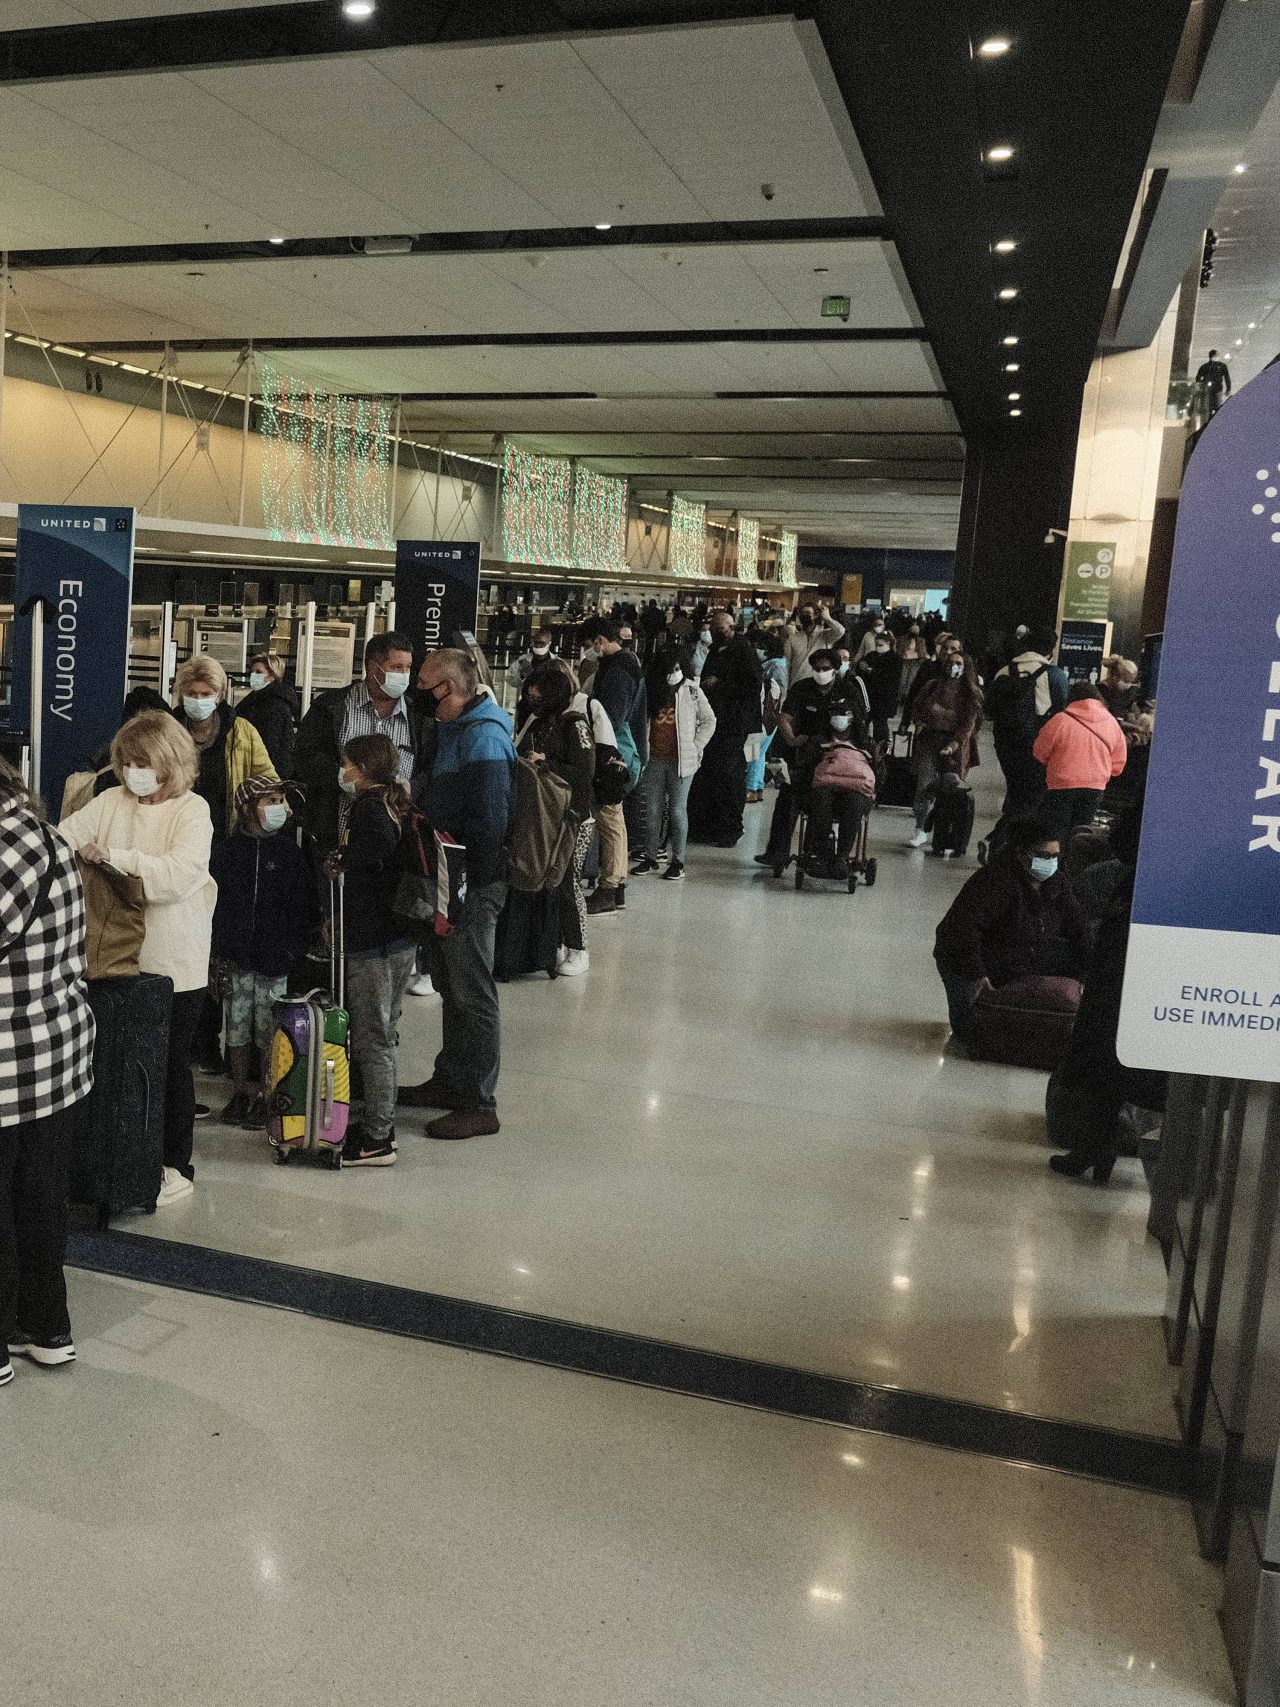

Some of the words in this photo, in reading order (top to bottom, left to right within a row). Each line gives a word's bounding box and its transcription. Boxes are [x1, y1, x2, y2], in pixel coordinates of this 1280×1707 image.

[41, 519, 91, 529] UNITED
[424, 583, 446, 653] Premi
[50, 580, 83, 722] Economy
[1181, 985, 1263, 1007] ENROLL
[1154, 1006, 1195, 1024] USE
[1201, 1010, 1280, 1032] IMMEDI
